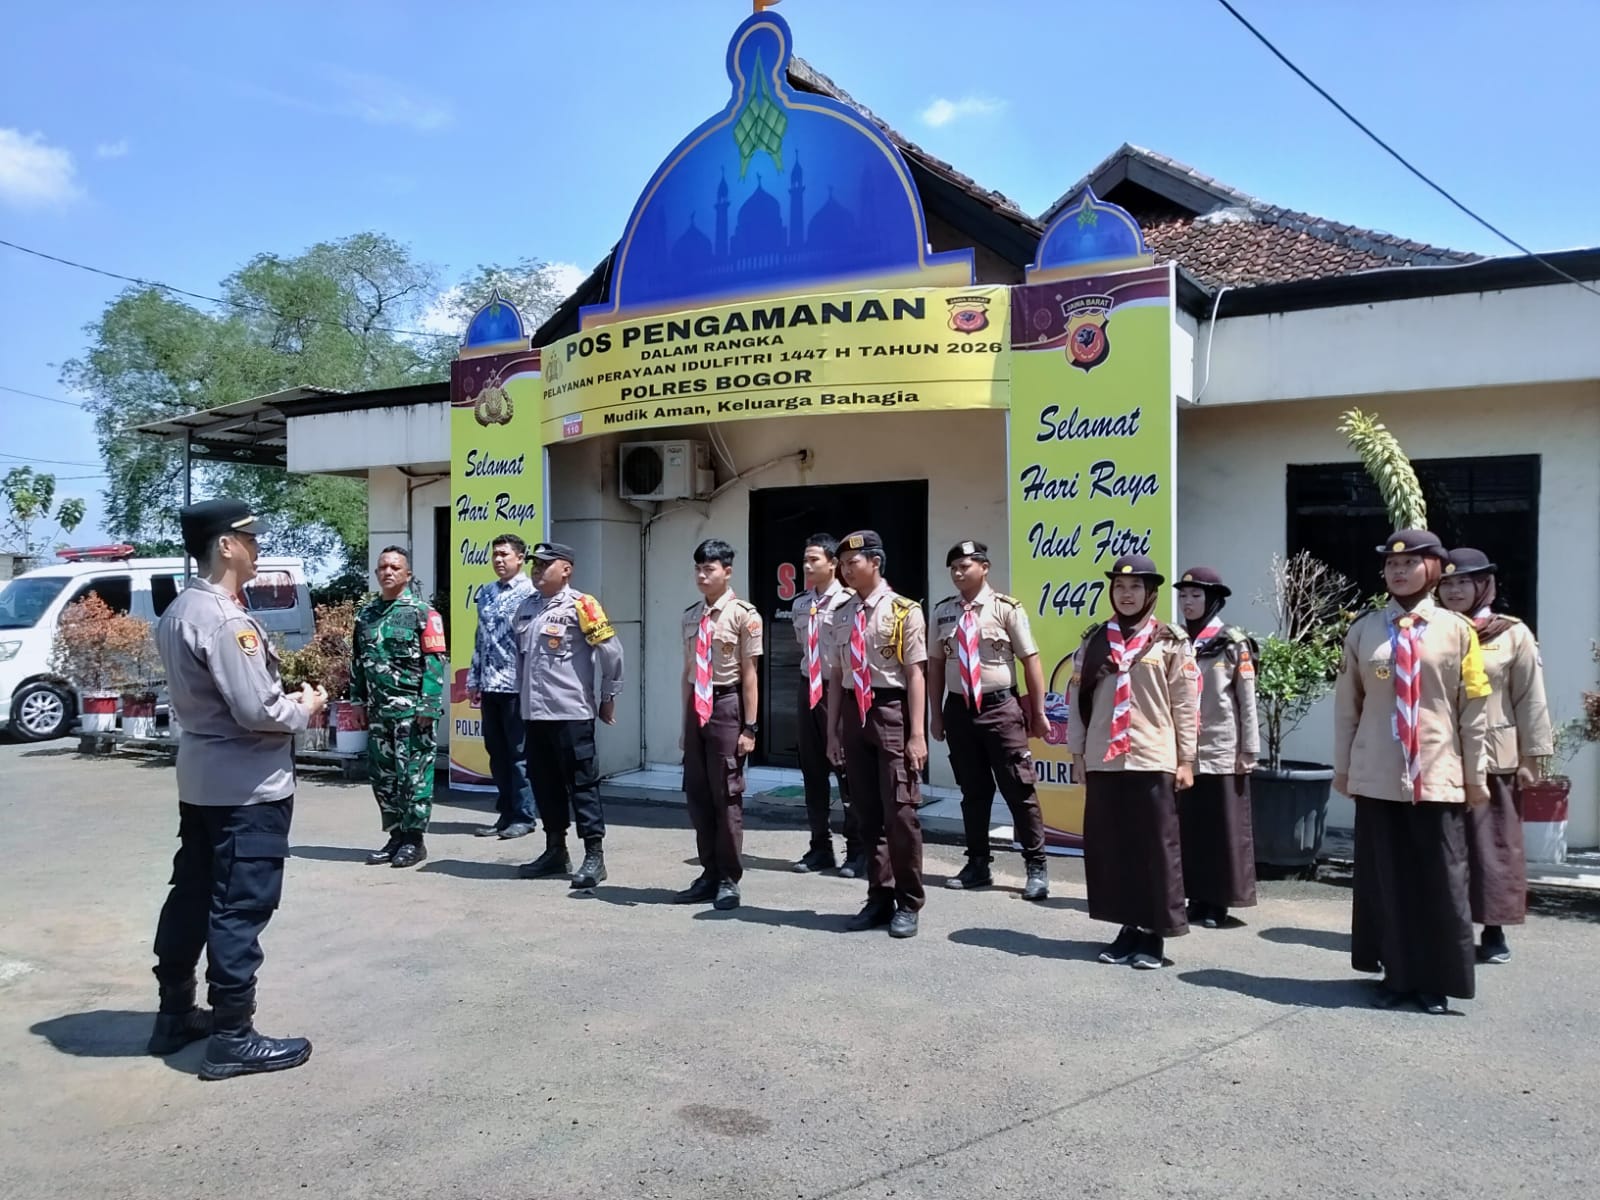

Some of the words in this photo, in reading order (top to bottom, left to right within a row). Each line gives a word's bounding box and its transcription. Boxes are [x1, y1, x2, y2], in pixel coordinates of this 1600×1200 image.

[1066, 299, 1085, 312] JAWA
[1085, 298, 1110, 307] BARAT
[566, 332, 612, 362] POS
[622, 298, 925, 348] PENGAMANAN
[641, 344, 698, 360] DALAM
[704, 335, 784, 352] RANGKA
[543, 376, 594, 400] PELAYANAN
[597, 364, 676, 384] PERAYAAN
[682, 353, 772, 372] IDULFITRI
[780, 349, 827, 361] 1447
[836, 348, 850, 358] H
[859, 344, 939, 357] TAHUN
[946, 342, 1003, 353] 2026
[621, 379, 707, 400] POLRES
[716, 370, 812, 390] BOGOR
[604, 410, 648, 424] Mudik
[654, 405, 711, 418] Aman,
[718, 397, 813, 412] Keluarga
[820, 390, 920, 406] Bahagia
[1036, 405, 1141, 442] Selamat
[465, 449, 524, 478] Selamat
[1020, 464, 1080, 501] Hari
[1089, 460, 1160, 506] Raya
[456, 494, 490, 522] Hari
[494, 493, 535, 527] Raya
[460, 538, 490, 567] Idul
[1028, 522, 1081, 559] Idul
[1091, 520, 1151, 564] Fitri
[1039, 582, 1105, 617] 1447
